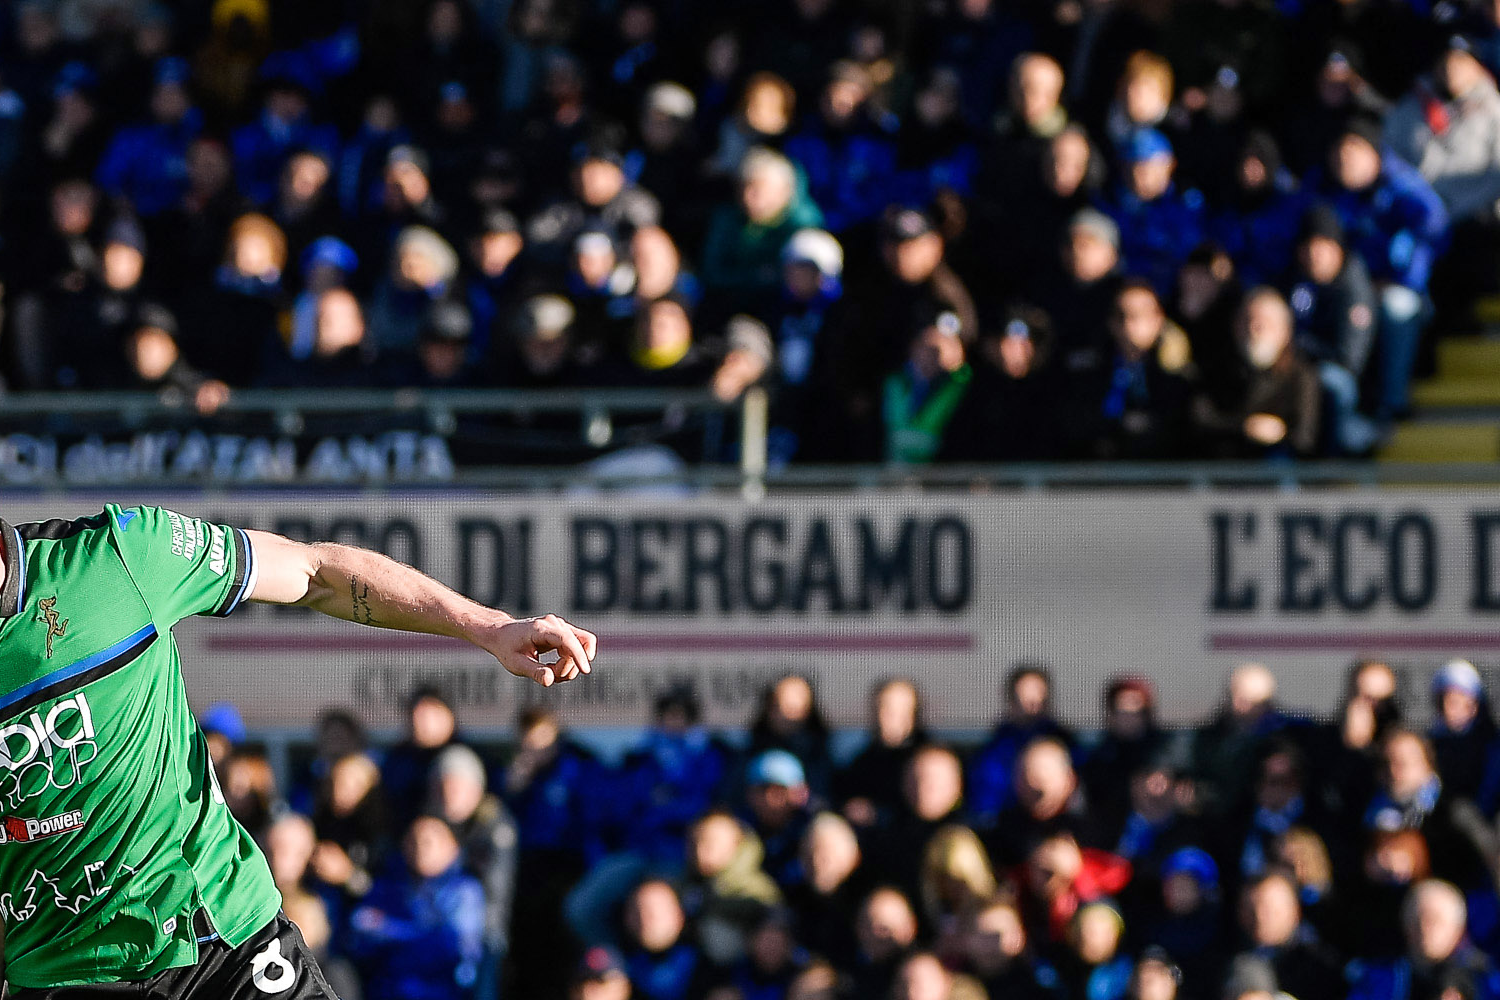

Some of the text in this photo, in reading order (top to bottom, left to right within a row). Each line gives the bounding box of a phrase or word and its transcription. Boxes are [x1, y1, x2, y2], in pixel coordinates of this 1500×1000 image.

[458, 516, 532, 616] DI
[573, 514, 976, 616] BERGAMO
[1211, 512, 1500, 614] L'ECO D
[250, 937, 297, 995] 6
